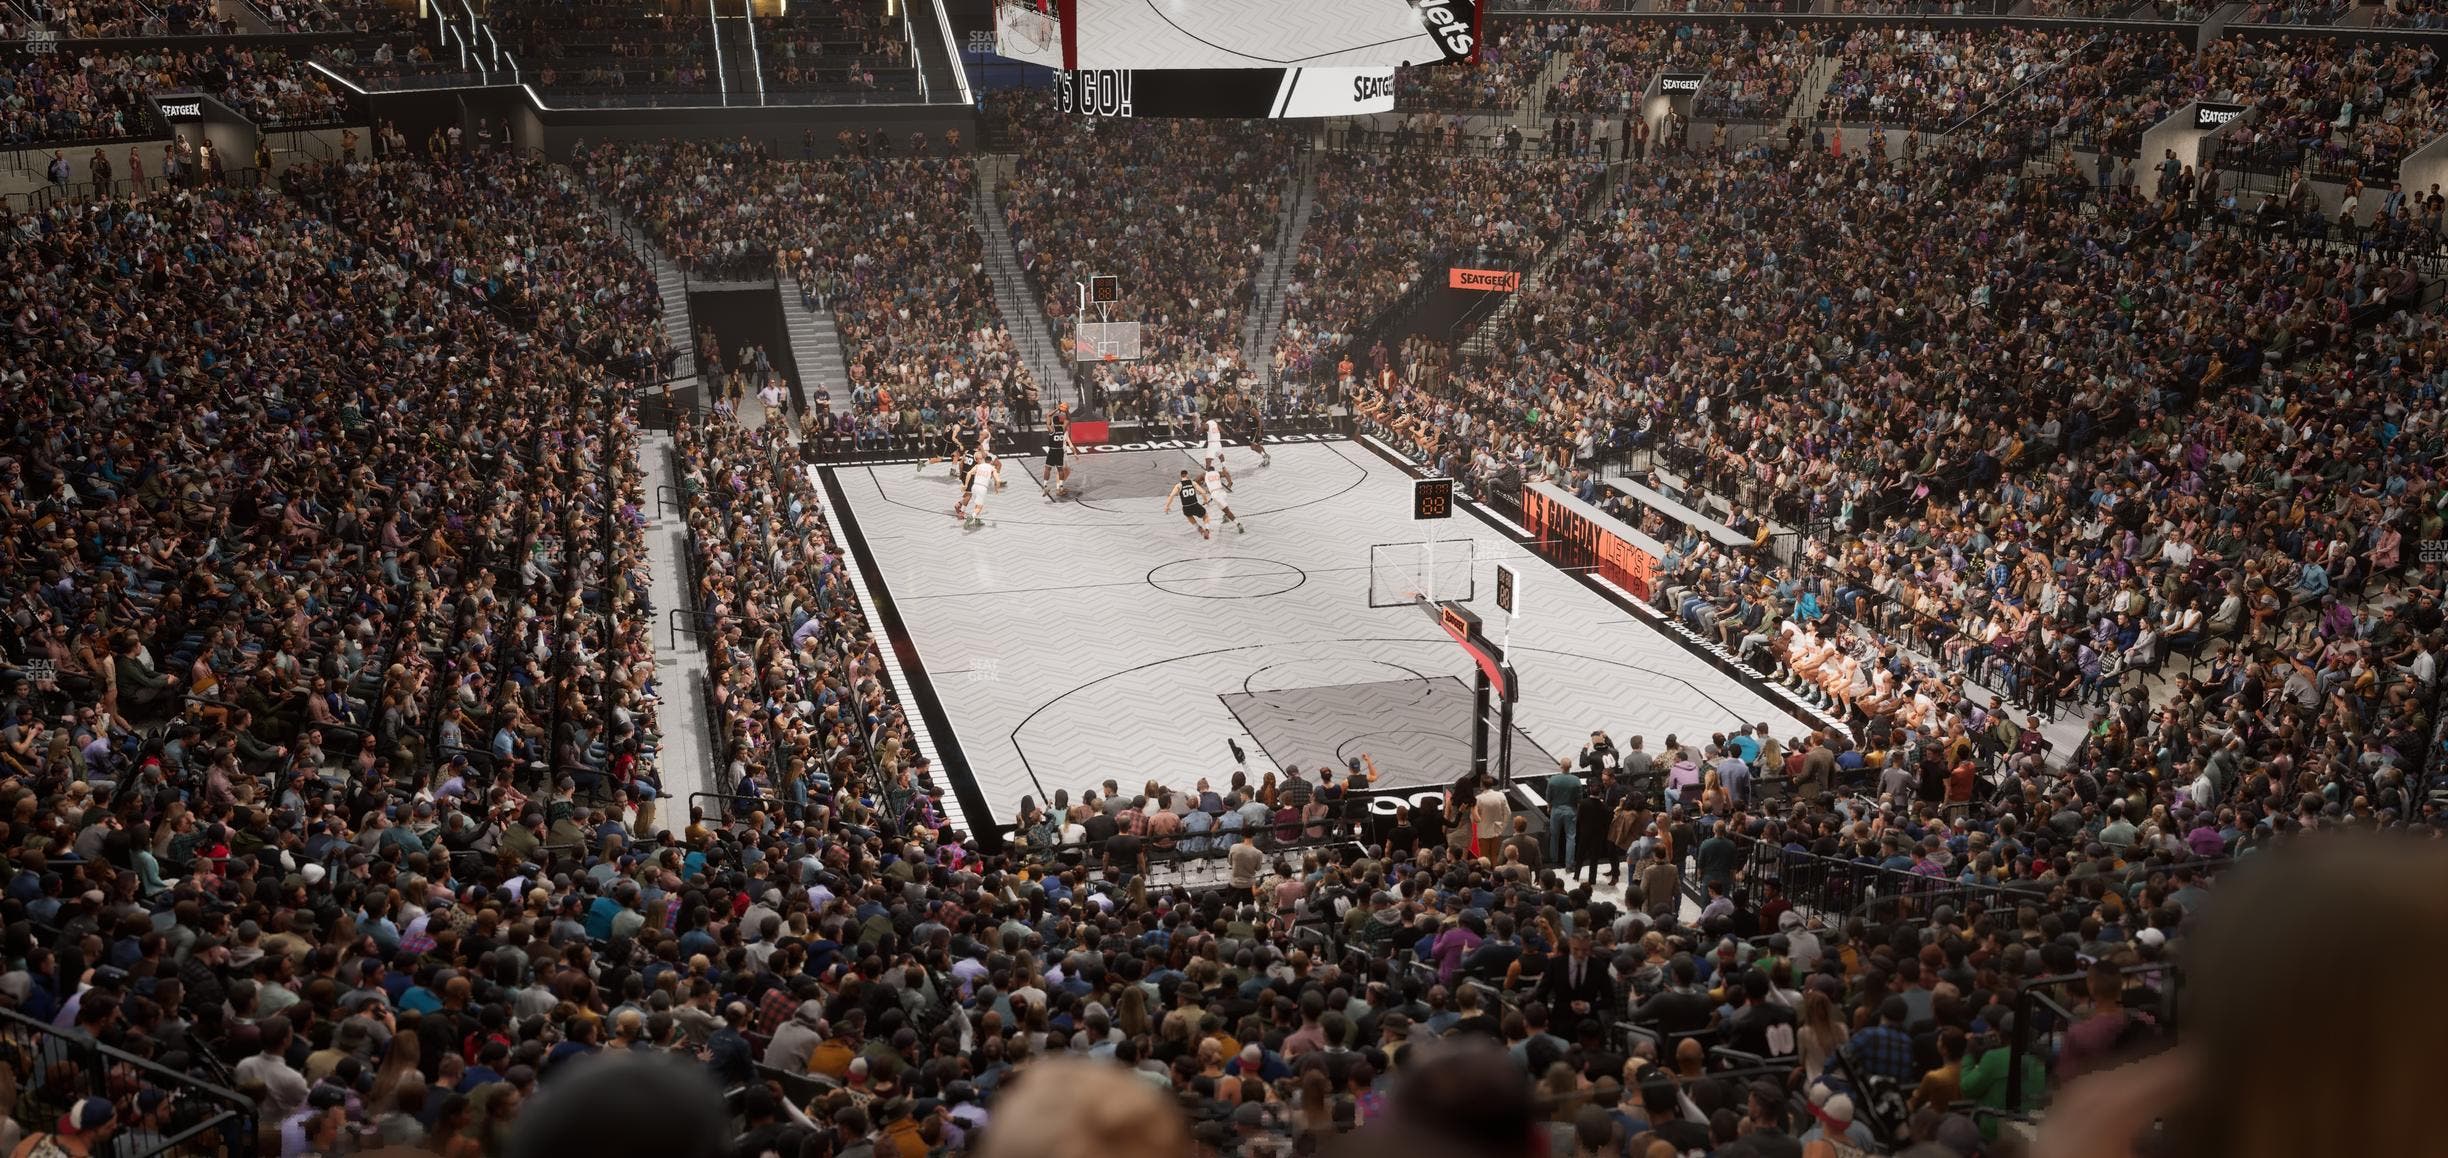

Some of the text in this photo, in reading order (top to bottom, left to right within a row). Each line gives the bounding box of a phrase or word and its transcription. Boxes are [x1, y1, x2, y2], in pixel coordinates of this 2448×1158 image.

[1080, 69, 1132, 117] GO!
[1354, 75, 1394, 102] SEATG
[1662, 79, 1700, 90] SEATGEEK
[162, 103, 200, 117] SEATGEEK
[1460, 272, 1512, 288] SEATGEEK
[1548, 498, 1602, 553] GAMEDAY
[1606, 530, 1644, 577] LET'S
